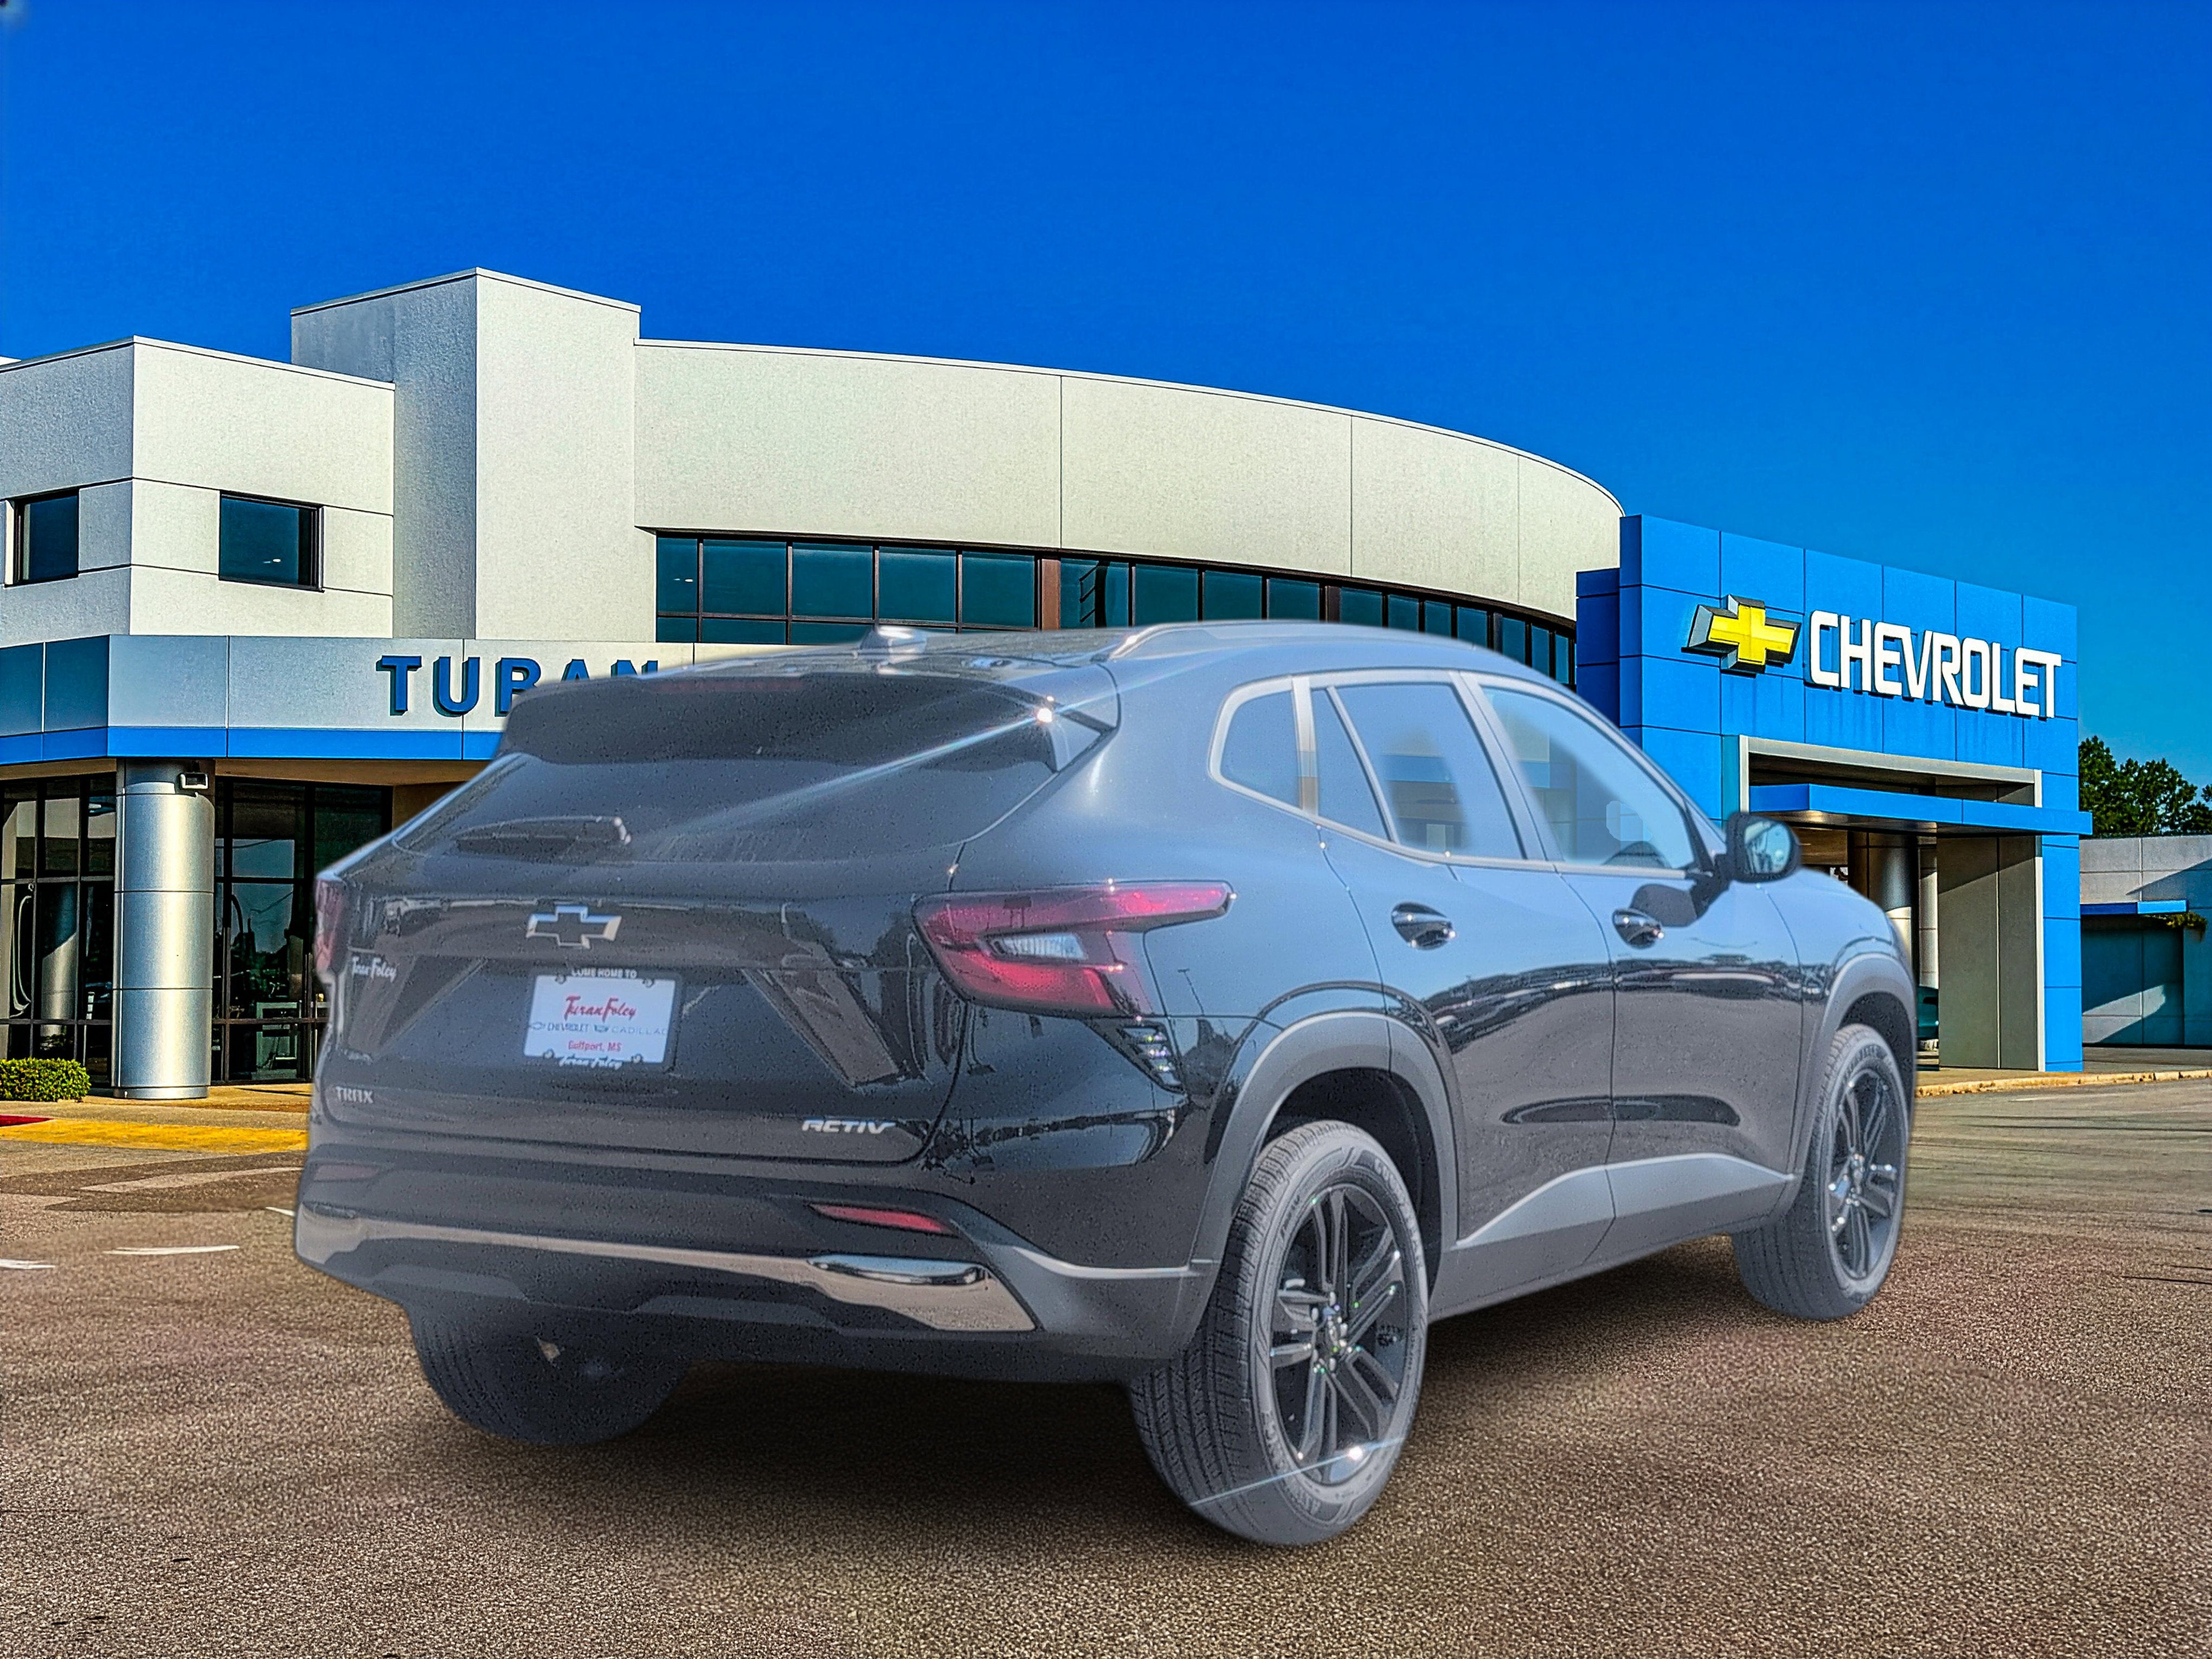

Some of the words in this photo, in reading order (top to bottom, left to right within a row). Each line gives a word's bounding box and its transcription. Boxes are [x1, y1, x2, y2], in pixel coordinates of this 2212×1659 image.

[1810, 609, 2062, 718] CHEVROLET
[625, 969, 638, 979] TO
[607, 1041, 622, 1052] MS
[336, 1085, 374, 1104] TRAX
[801, 1119, 896, 1134] ACTIV
